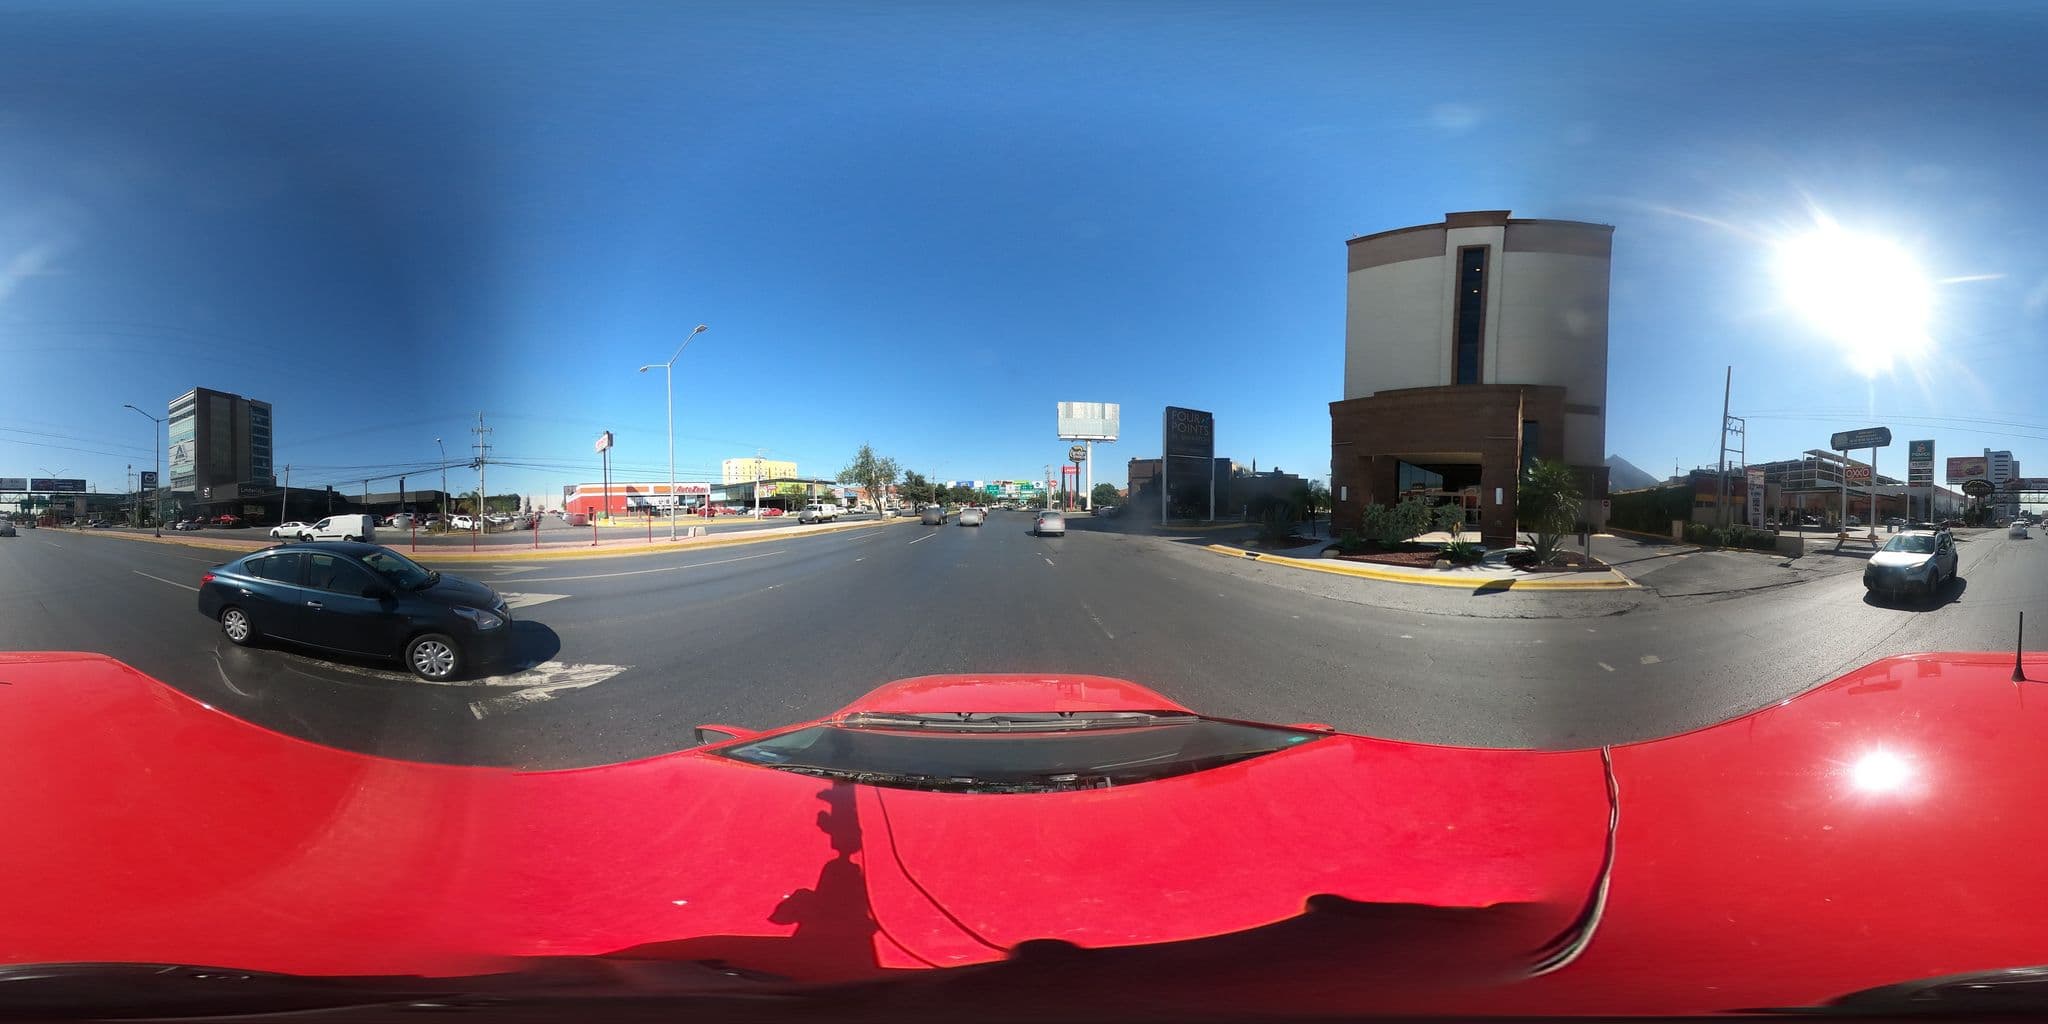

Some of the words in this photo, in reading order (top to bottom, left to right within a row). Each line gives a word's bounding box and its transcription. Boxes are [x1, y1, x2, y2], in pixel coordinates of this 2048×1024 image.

[1172, 410, 1200, 423] FOUR
[1172, 422, 1209, 435] POINTS
[1846, 468, 1870, 478] OXXO
